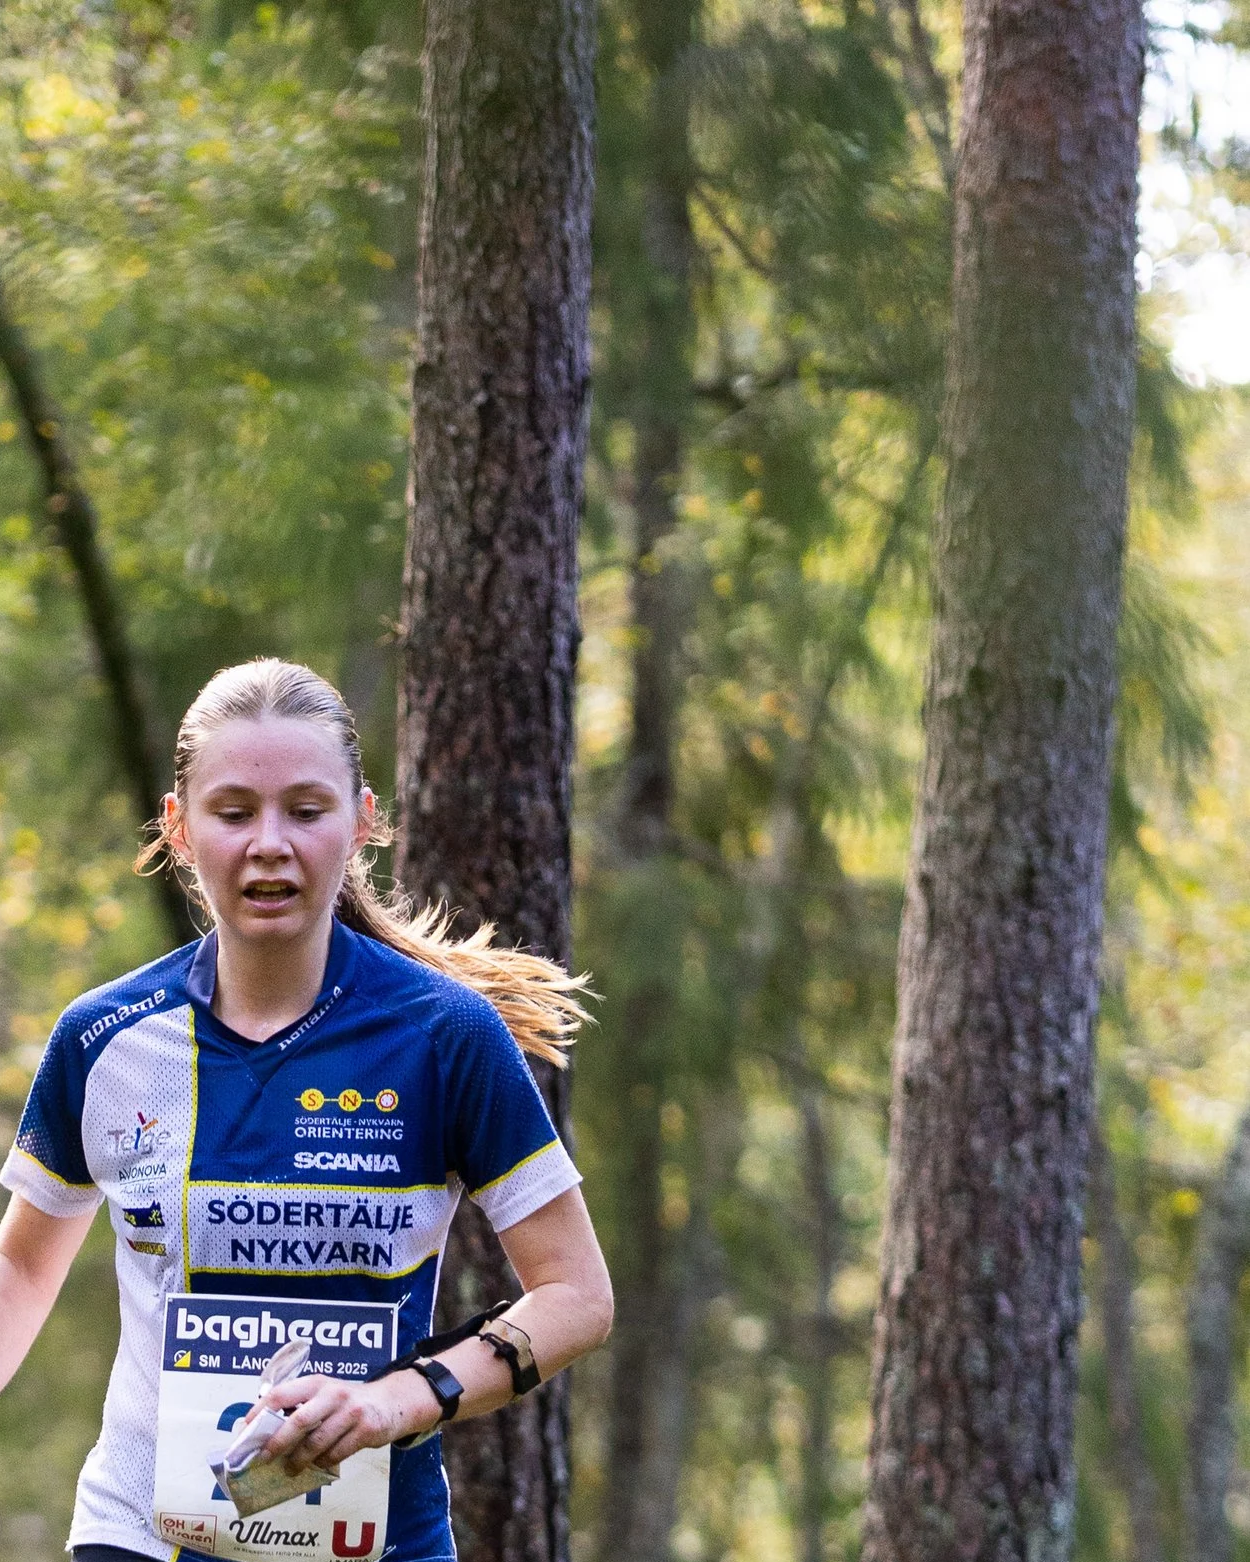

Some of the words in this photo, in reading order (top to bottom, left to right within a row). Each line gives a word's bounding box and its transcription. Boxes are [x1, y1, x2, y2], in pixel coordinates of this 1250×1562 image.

[80, 989, 166, 1050] noname
[294, 1116, 352, 1127] SÖDERTÄLJE
[358, 1118, 404, 1127] NYKVARN
[294, 1126, 404, 1140] ORIENTERING
[118, 1162, 167, 1181] AVONOVA
[293, 1151, 401, 1173] SCANIA
[207, 1194, 413, 1235] SÖDERTÄLJE
[230, 1238, 393, 1268] NYKVARN
[176, 1307, 383, 1349] bagheera
[199, 1354, 220, 1368] SM
[337, 1362, 368, 1375] 2025
[229, 1519, 319, 1547] Ullmax
[331, 1520, 376, 1558] U
